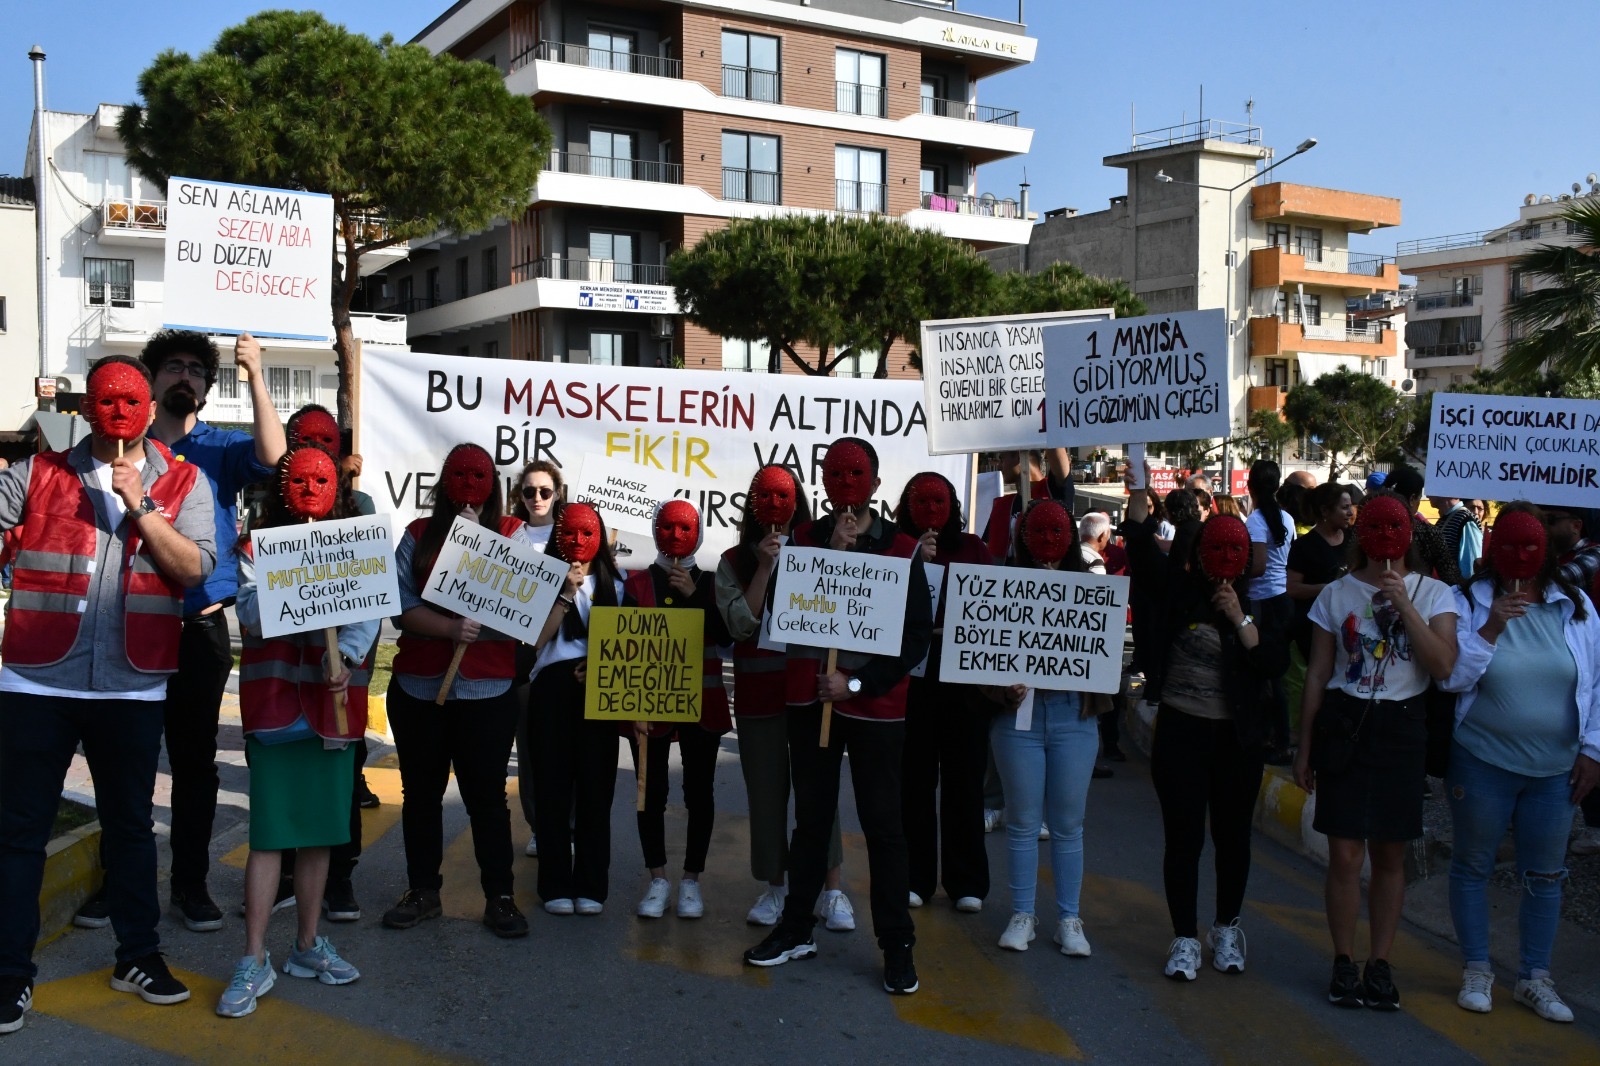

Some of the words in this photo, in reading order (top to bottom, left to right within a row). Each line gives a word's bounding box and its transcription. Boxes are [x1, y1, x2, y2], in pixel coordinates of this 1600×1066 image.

[995, 41, 1018, 54] LIFE
[179, 184, 218, 208] SEN
[228, 190, 302, 220] AĞLAMA
[217, 217, 274, 243] SEZEN
[278, 225, 311, 248] ABLA
[178, 240, 201, 263] BU
[214, 243, 272, 268] DÜZEN
[216, 270, 318, 299] DEĞİŞECEK
[938, 331, 1002, 352] İNSANCA
[1085, 331, 1101, 360] 1
[940, 354, 1005, 376] İNSANCA
[1073, 352, 1207, 394] GİDİYORMUŞ
[940, 378, 984, 399] GÜVENLİ
[989, 376, 1008, 397] BİR
[426, 370, 482, 412] BU
[504, 377, 755, 431] MASKELERİN
[769, 393, 928, 437] ALTINDA
[940, 400, 1004, 421] HAKLARIMIZ
[1059, 398, 1080, 429] İKİ
[1084, 393, 1160, 425] GÖZÜMÜN
[1165, 382, 1219, 419] ÇİÇEĞİ
[1440, 405, 1475, 428] İŞÇİ
[1482, 408, 1576, 430] ÇOCUKLARI
[494, 421, 563, 469] BİR
[605, 427, 717, 479] FİKİR
[606, 475, 648, 493] HAKSIZ
[1436, 459, 1492, 480] KADAR
[1498, 461, 1600, 487] SEVİMLİDİR
[385, 470, 436, 510] VE
[587, 484, 625, 501] RANTA
[257, 535, 307, 557] Kırmızı
[310, 525, 387, 548] Maskelerin
[449, 522, 481, 552] Kanlı
[300, 547, 355, 567] Altında
[786, 553, 806, 573] Bu
[811, 556, 899, 584] Maskelerin
[267, 556, 387, 590] MUTLULUĞUN
[456, 551, 539, 603] MUTLU
[813, 576, 872, 598] Altında
[298, 578, 362, 600] Gücüyle
[434, 570, 449, 593] 1
[448, 578, 533, 629] Mayıslara
[956, 573, 997, 597] YÜZ
[1003, 579, 1066, 602] KARASI
[1074, 585, 1121, 607] DEĞİL
[279, 592, 391, 626] Aydınlanırız
[789, 592, 837, 614] Mutlu
[847, 598, 873, 617] Bir
[962, 600, 1035, 625] KÖMÜR
[1042, 606, 1107, 632] KARASI
[617, 609, 670, 638] DÜNYA
[777, 612, 840, 636] Gelecek
[848, 620, 884, 641] Var
[600, 638, 687, 663] KADININ
[954, 624, 1012, 647] BÖYLE
[1018, 630, 1109, 658] KAZANILIR
[598, 662, 693, 691] EMEĞİYLE
[959, 650, 1019, 673] EKMEK
[1026, 655, 1090, 680] PARASI
[598, 689, 698, 717] DEĞİŞECEK
